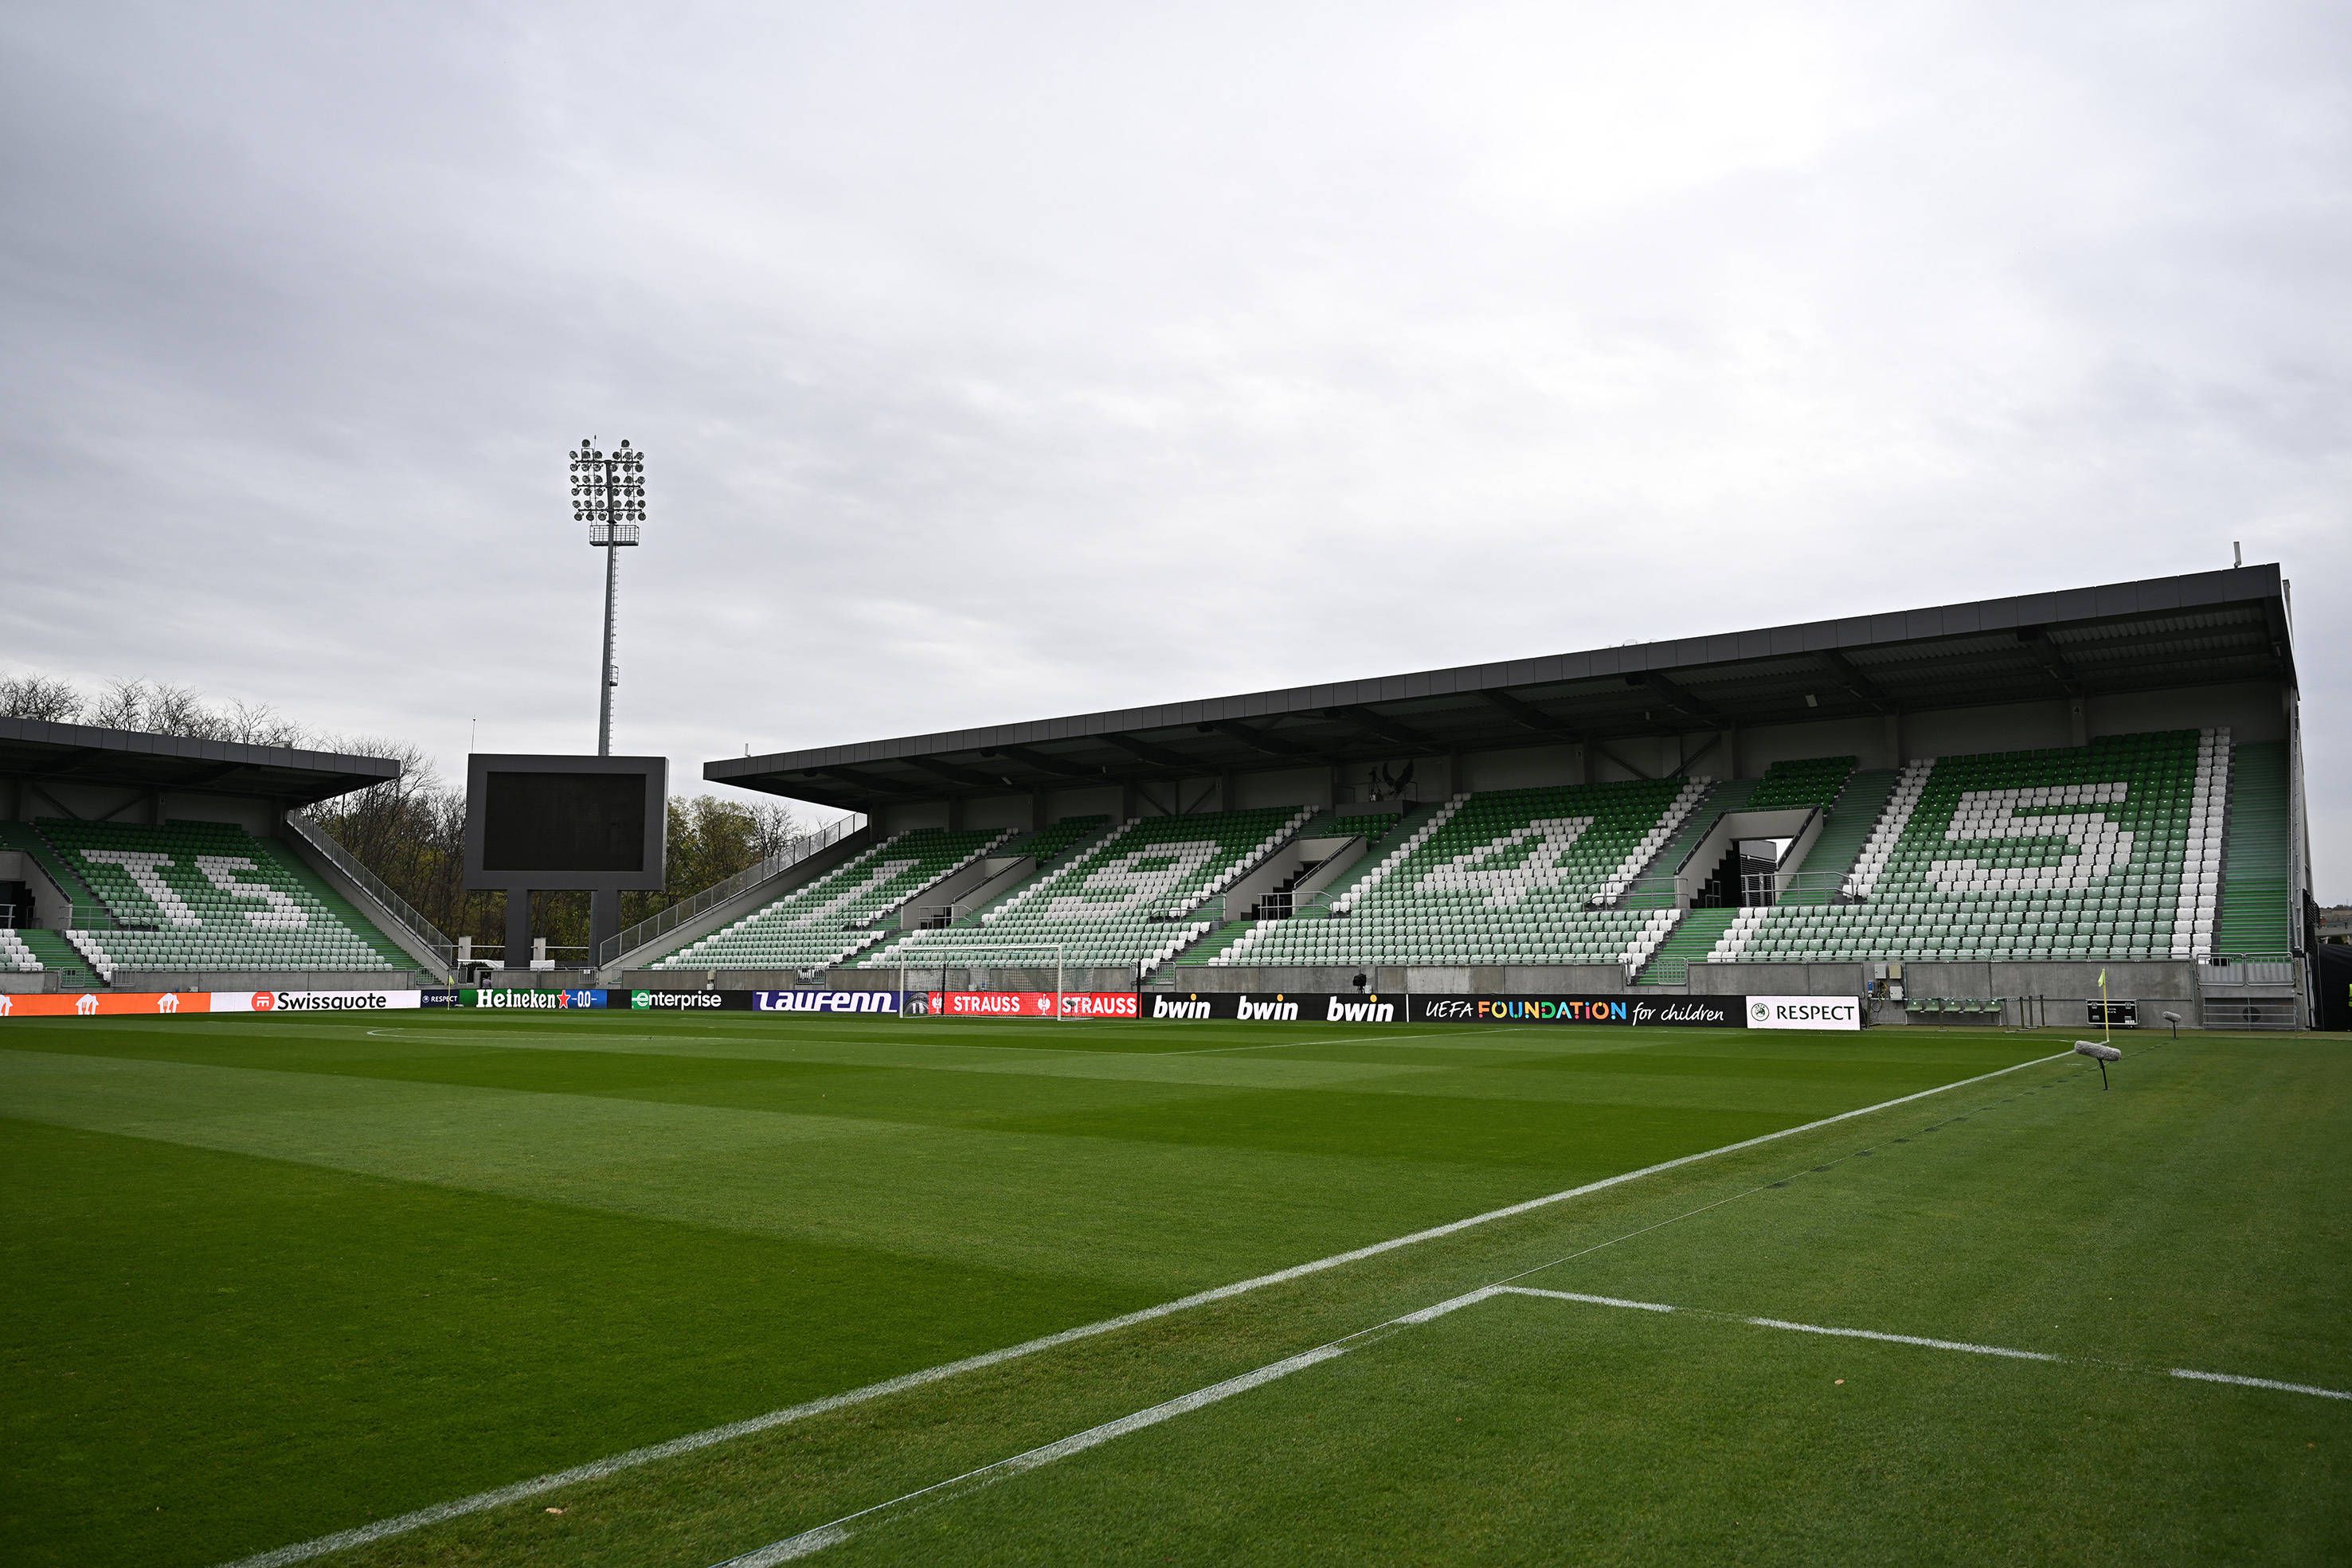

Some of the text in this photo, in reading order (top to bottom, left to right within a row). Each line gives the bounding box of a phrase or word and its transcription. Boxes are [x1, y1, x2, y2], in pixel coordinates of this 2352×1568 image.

[277, 992, 387, 1011] Swissquote
[476, 989, 557, 1009] Heineken
[636, 991, 722, 1010] enterprise
[954, 995, 1020, 1012] STRAUSS
[1062, 997, 1137, 1014] STRAUSS
[1153, 993, 1211, 1019] bwin
[1236, 994, 1299, 1021] bwin
[1326, 994, 1395, 1023] bwin
[1426, 1000, 1724, 1026] UEFA FOUNDATION for children
[1777, 1005, 1855, 1021] RESPECT
